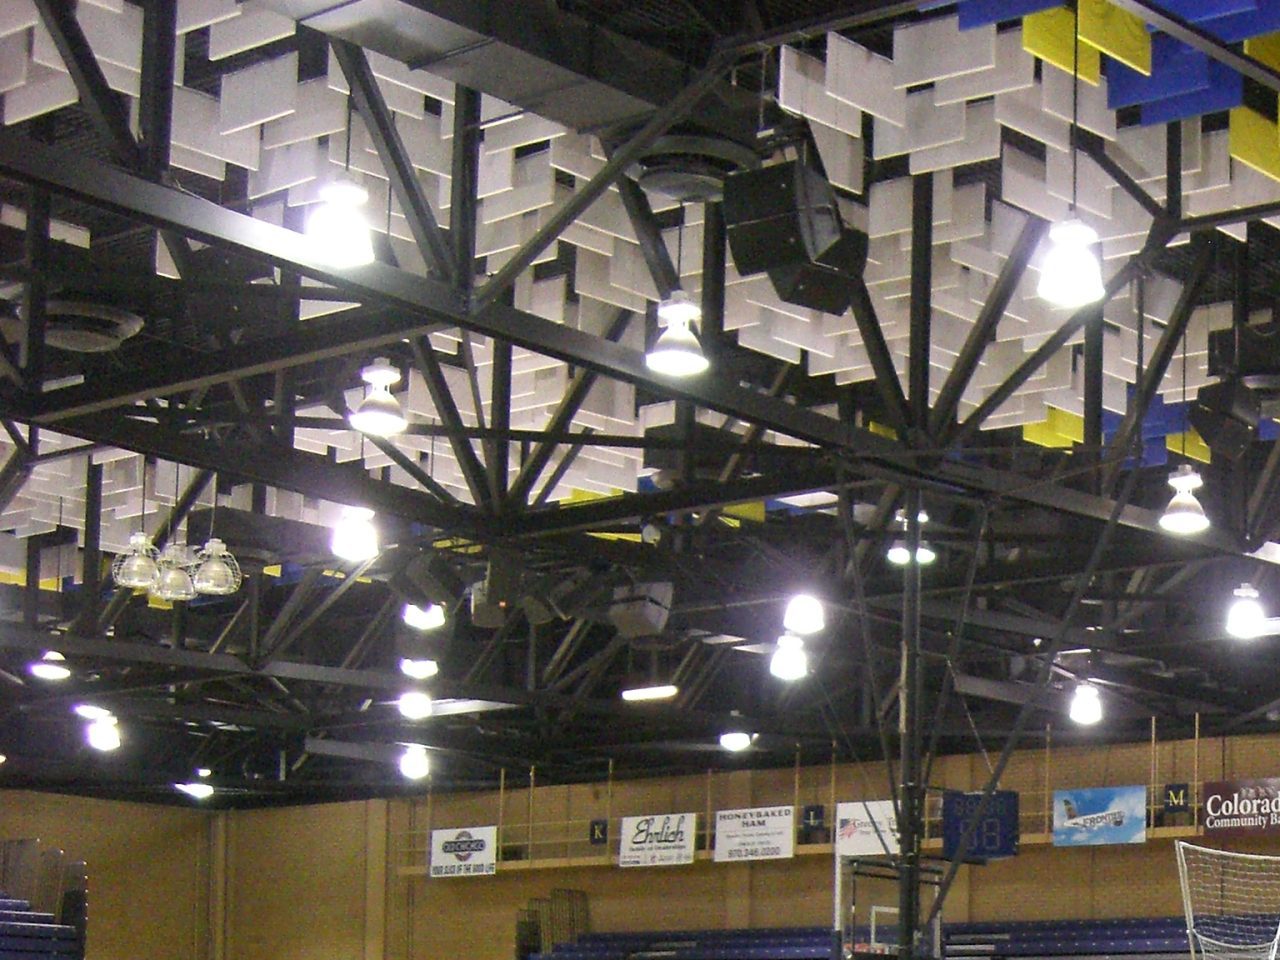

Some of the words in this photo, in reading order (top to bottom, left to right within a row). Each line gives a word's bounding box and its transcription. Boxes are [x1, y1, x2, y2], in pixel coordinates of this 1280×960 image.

[1169, 789, 1184, 807] M
[719, 808, 791, 821] HONEYBAKED
[810, 810, 818, 826] L
[1206, 814, 1268, 829] Community
[632, 815, 685, 845] Ehrlich
[742, 819, 766, 828] HAM
[594, 824, 603, 839] K
